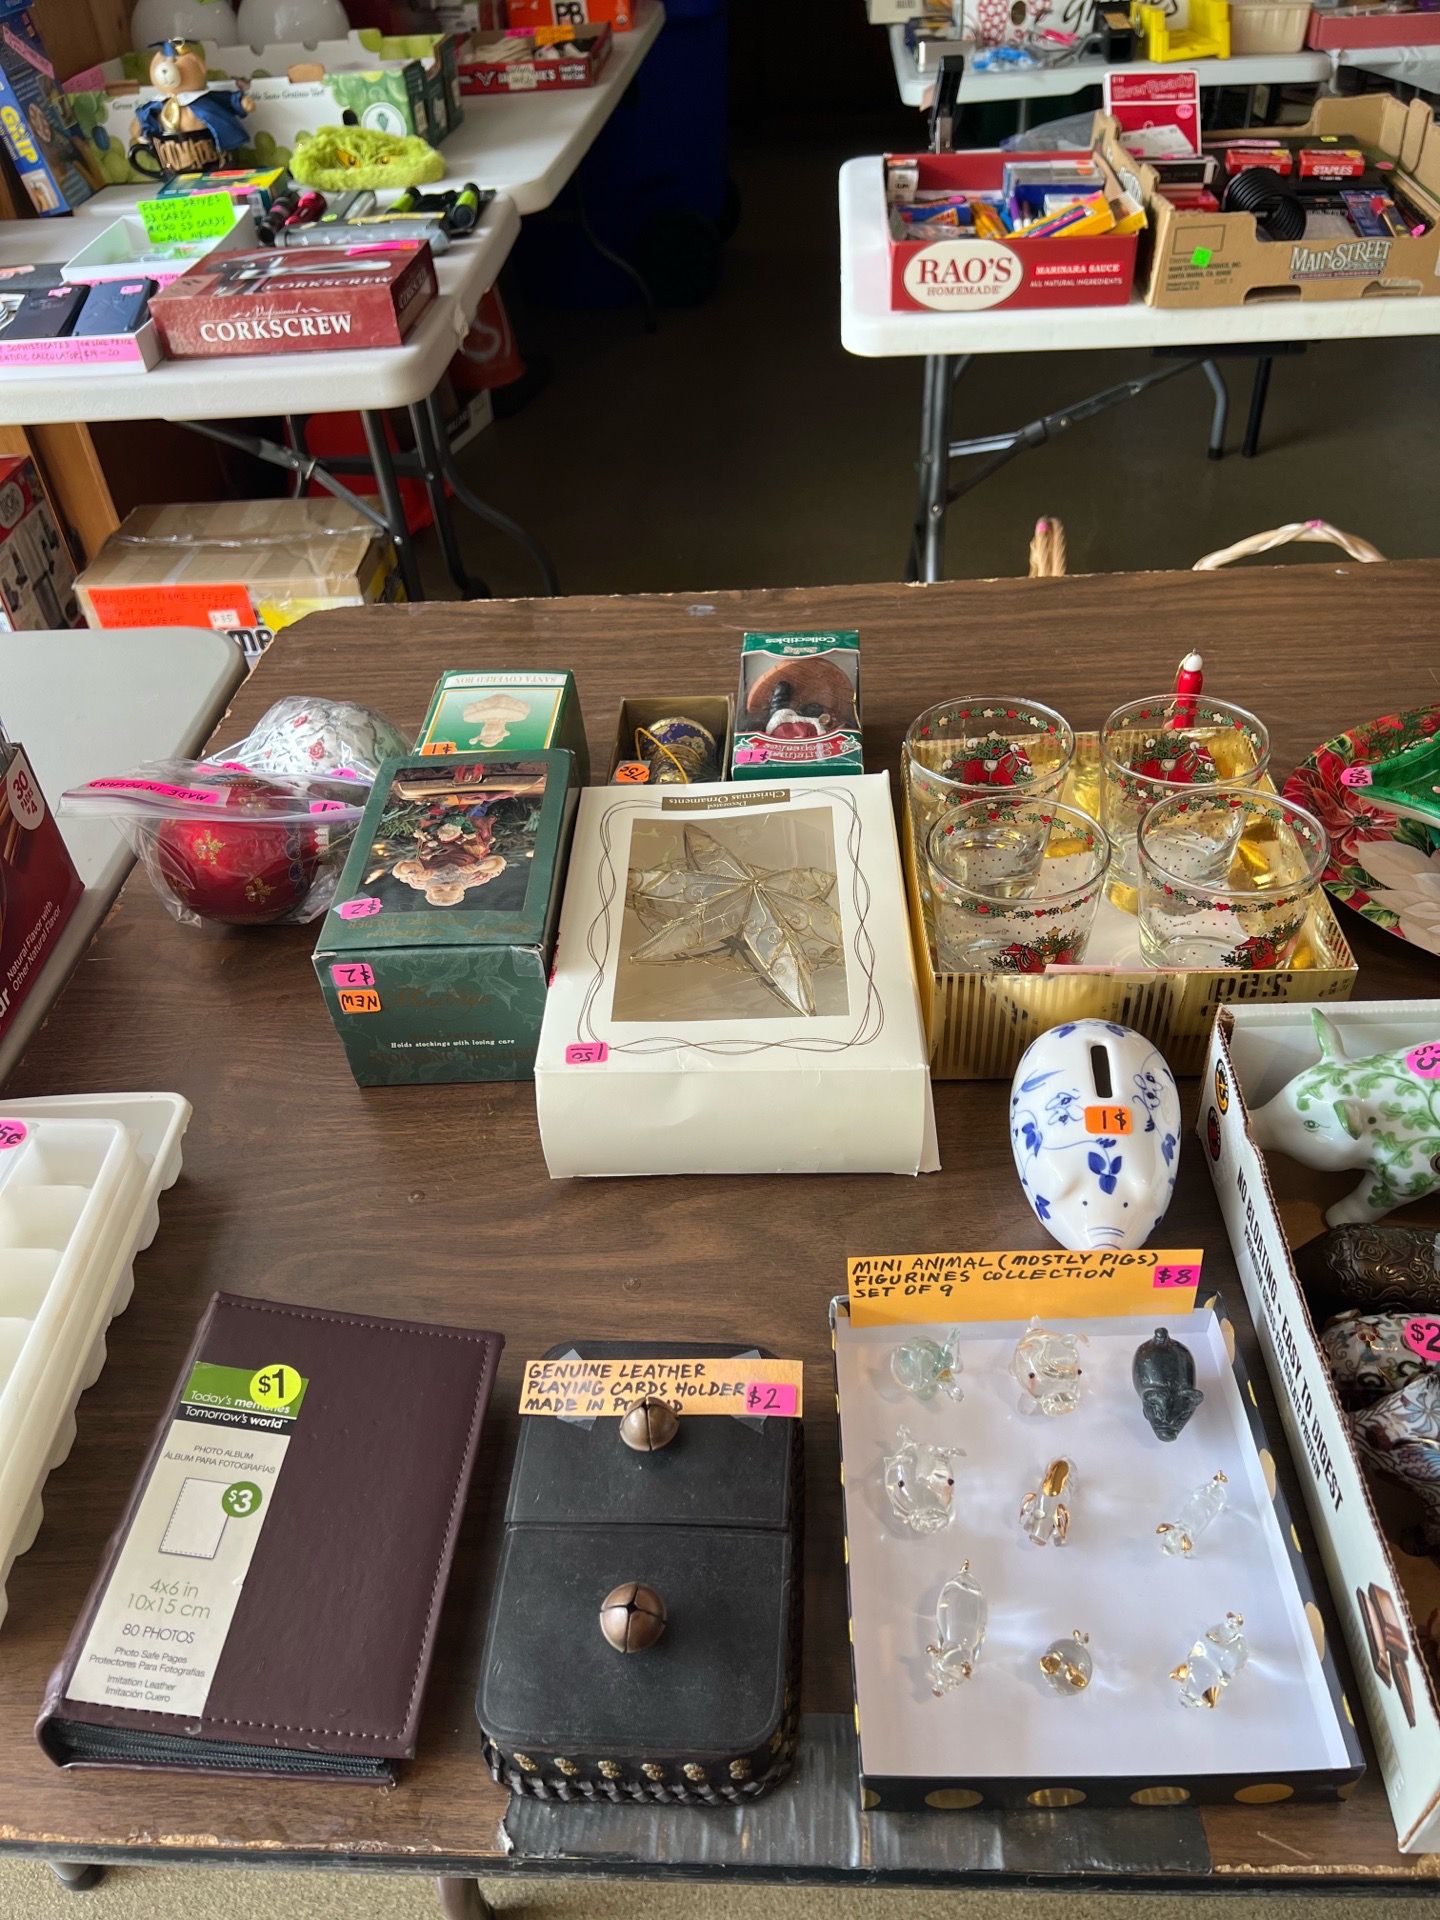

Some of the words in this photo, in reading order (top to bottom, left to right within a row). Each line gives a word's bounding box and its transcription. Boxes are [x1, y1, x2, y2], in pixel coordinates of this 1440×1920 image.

[1312, 165, 1354, 176] STAPLES
[916, 257, 1014, 284] RAO'S
[1035, 264, 1088, 276] MARINARA
[1088, 263, 1121, 274] SAUCE
[264, 276, 393, 292] CORKSCREW
[926, 285, 1002, 297] HOMEMADE
[1044, 279, 1075, 288] NATURAL
[199, 313, 352, 343] CORKSCREW
[765, 636, 836, 645] Collectibles
[13, 770, 29, 801] 30
[89, 781, 143, 789] POLAND
[1347, 768, 1371, 786] 50¢
[167, 789, 210, 801] MADE
[669, 794, 729, 805] Ornaments
[729, 789, 786, 802] Christmas
[707, 800, 748, 810] Decorated
[350, 899, 382, 914] $2
[6, 943, 28, 981] Natural
[25, 918, 43, 949] Flavor
[41, 900, 53, 921] with
[12, 963, 30, 991] Other
[27, 929, 48, 965] Natural
[44, 904, 61, 932] Flavor
[338, 964, 371, 986] $2
[340, 992, 378, 1011] NEW
[390, 1041, 413, 1049] Holds
[415, 1039, 450, 1048] stockings
[453, 1038, 470, 1046] with
[471, 1038, 495, 1047] loving
[1102, 1108, 1127, 1131] $1
[853, 1259, 903, 1275] MINI
[912, 1255, 995, 1271] ANIMAL
[998, 1254, 1097, 1271] (MOSTLY
[1099, 1252, 1159, 1268] PIGS)
[853, 1269, 971, 1286] FIGURINES
[982, 1267, 1116, 1281] COLLECTION
[1157, 1268, 1193, 1287] $8
[853, 1285, 896, 1299] SET
[904, 1284, 932, 1296] OF
[942, 1284, 954, 1297] 9
[1236, 1164, 1248, 1203] NO
[1245, 1195, 1278, 1305] BLOATING
[1281, 1315, 1303, 1380] EASY
[1300, 1376, 1313, 1419] TO
[1311, 1413, 1344, 1513] DIGEST
[1410, 1322, 1440, 1353] $2
[528, 1363, 613, 1379] GENUINE
[618, 1363, 706, 1380] LEATHER
[258, 1368, 286, 1400] $1
[527, 1381, 605, 1397] PLAYING
[610, 1381, 668, 1397] CARDS
[674, 1382, 746, 1397] HOLDER
[191, 1389, 233, 1406] Today's
[524, 1396, 578, 1413] MADE
[585, 1397, 604, 1412] IN
[612, 1398, 684, 1412] POD
[746, 1386, 781, 1410] $2
[185, 1405, 248, 1424] Tomorrow's
[193, 1445, 225, 1456] PHOTO
[224, 1448, 254, 1460] ALBUM
[1300, 1415, 1322, 1482] PROTEIN
[194, 1456, 217, 1467] PARA
[228, 1488, 254, 1513] $3
[150, 1578, 179, 1597] 4x6
[183, 1581, 199, 1598] in
[127, 1592, 178, 1615] 10x15
[180, 1606, 211, 1620] cm
[122, 1623, 140, 1637] 80
[142, 1625, 197, 1644] PHOTOS
[88, 1654, 138, 1669] Protectores
[138, 1661, 158, 1672] Para
[114, 1646, 140, 1658] Photo
[141, 1651, 161, 1661] Safe
[161, 1652, 188, 1665] Pages
[107, 1674, 143, 1687] Imitation
[144, 1681, 177, 1692] Leather
[144, 1691, 171, 1703] Cuero
